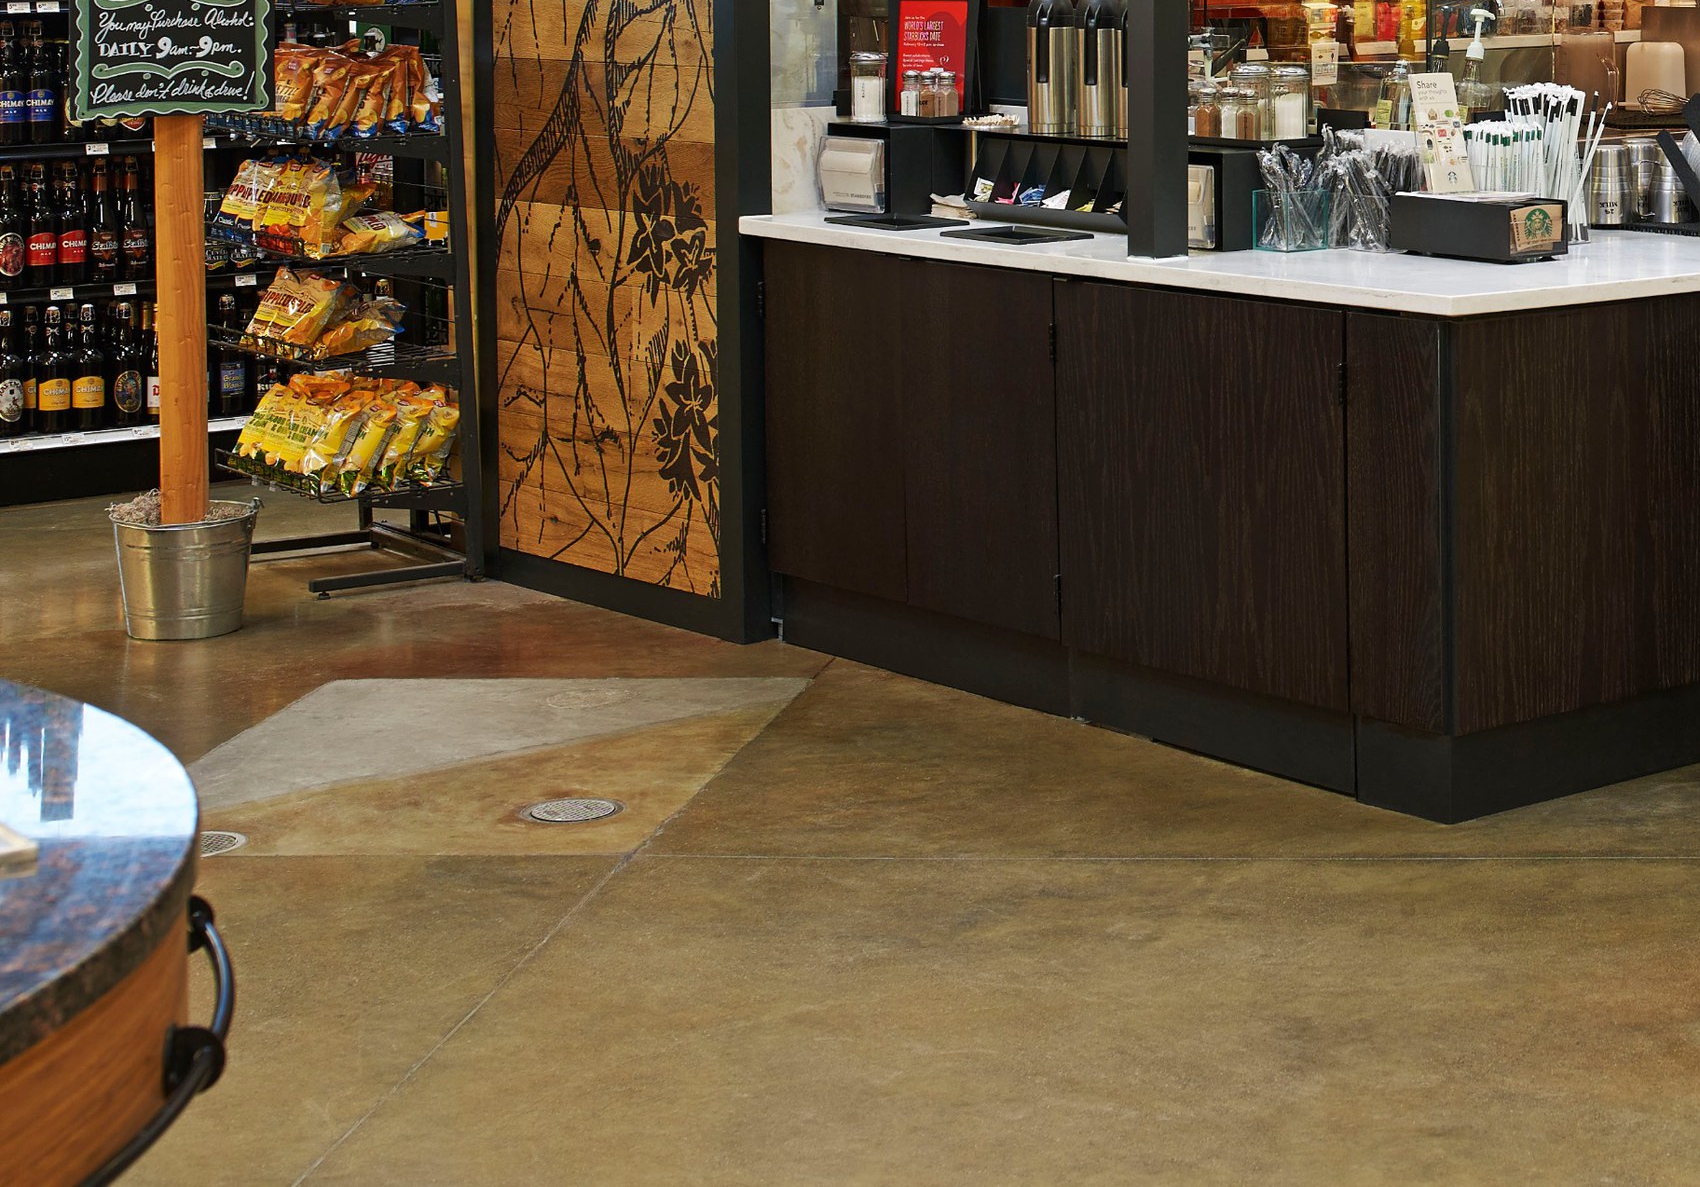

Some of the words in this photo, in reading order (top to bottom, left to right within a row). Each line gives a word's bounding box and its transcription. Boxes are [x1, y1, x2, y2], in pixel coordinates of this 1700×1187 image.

[98, 42, 155, 57] DAILY
[1416, 80, 1437, 89] Share
[91, 83, 136, 104] Please
[135, 79, 175, 100] don't
[171, 78, 207, 99] drink
[26, 98, 54, 107] CHIMAY
